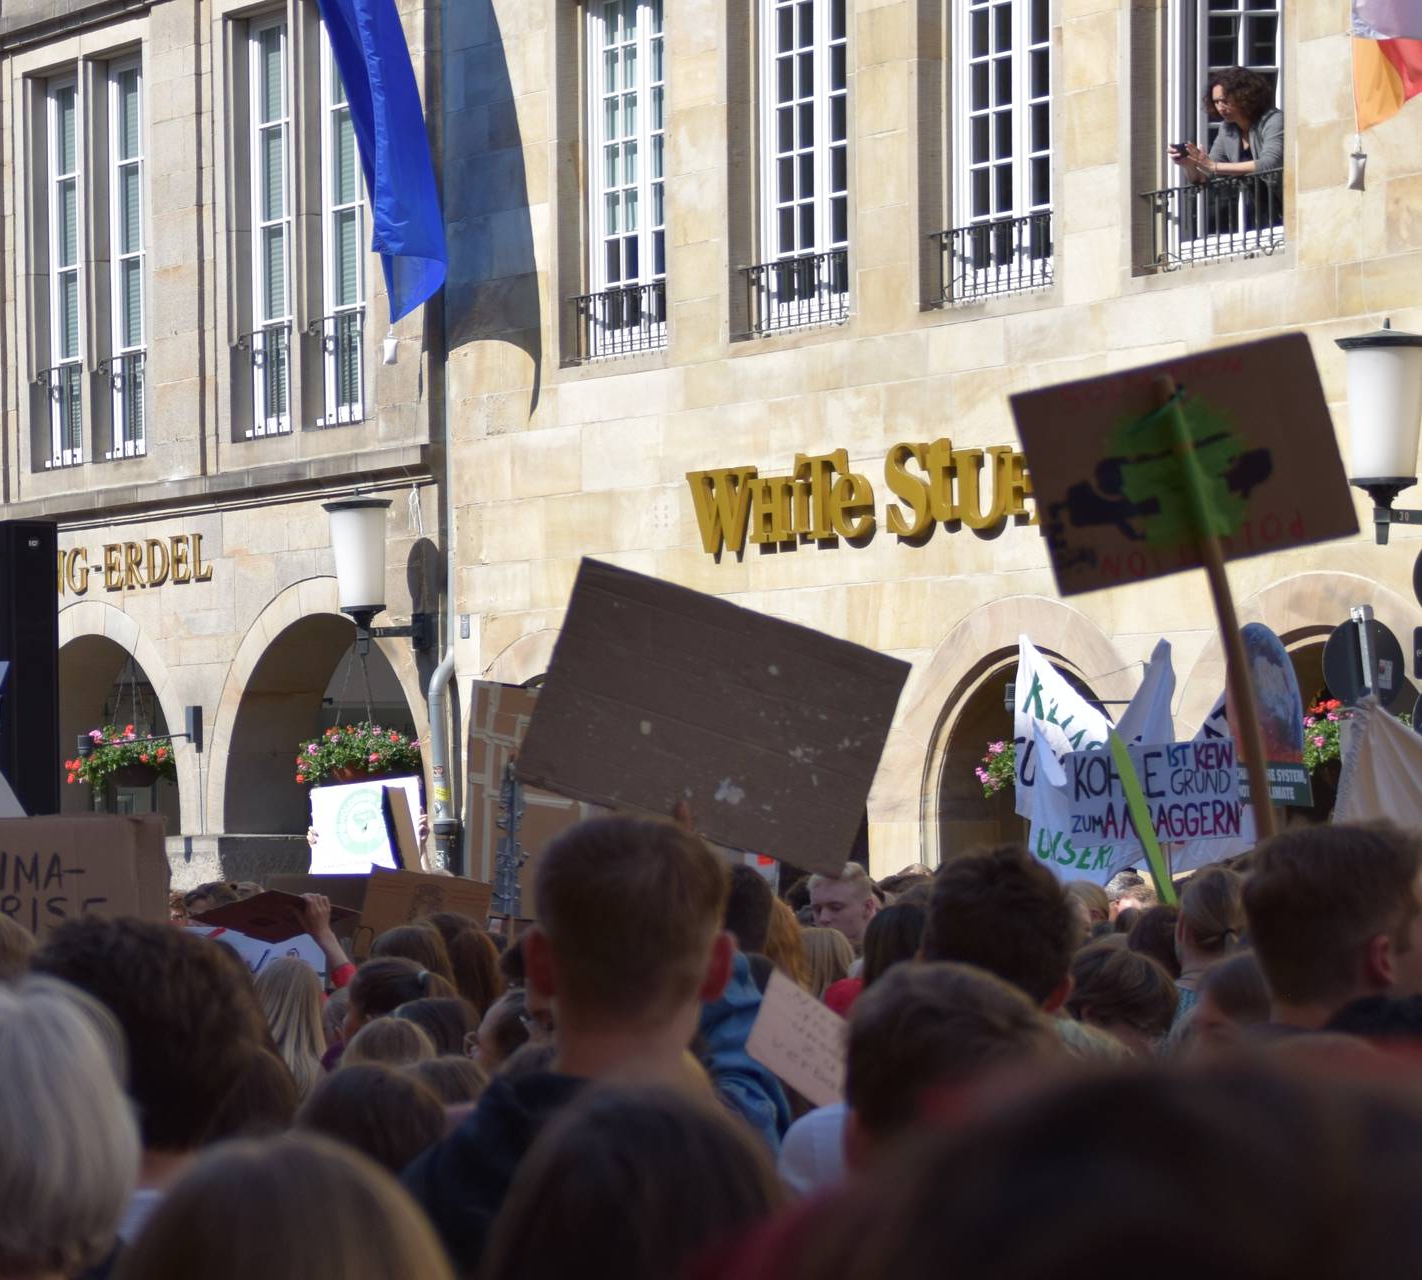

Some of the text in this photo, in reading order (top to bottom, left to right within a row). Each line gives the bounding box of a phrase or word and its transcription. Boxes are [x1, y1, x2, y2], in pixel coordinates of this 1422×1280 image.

[1073, 751, 1165, 802] KOHE
[1166, 743, 1190, 768] IST
[1170, 768, 1231, 796] GRUND
[1268, 785, 1296, 801] LIMATE
[1070, 799, 1241, 839] ZUM ANAGGERN
